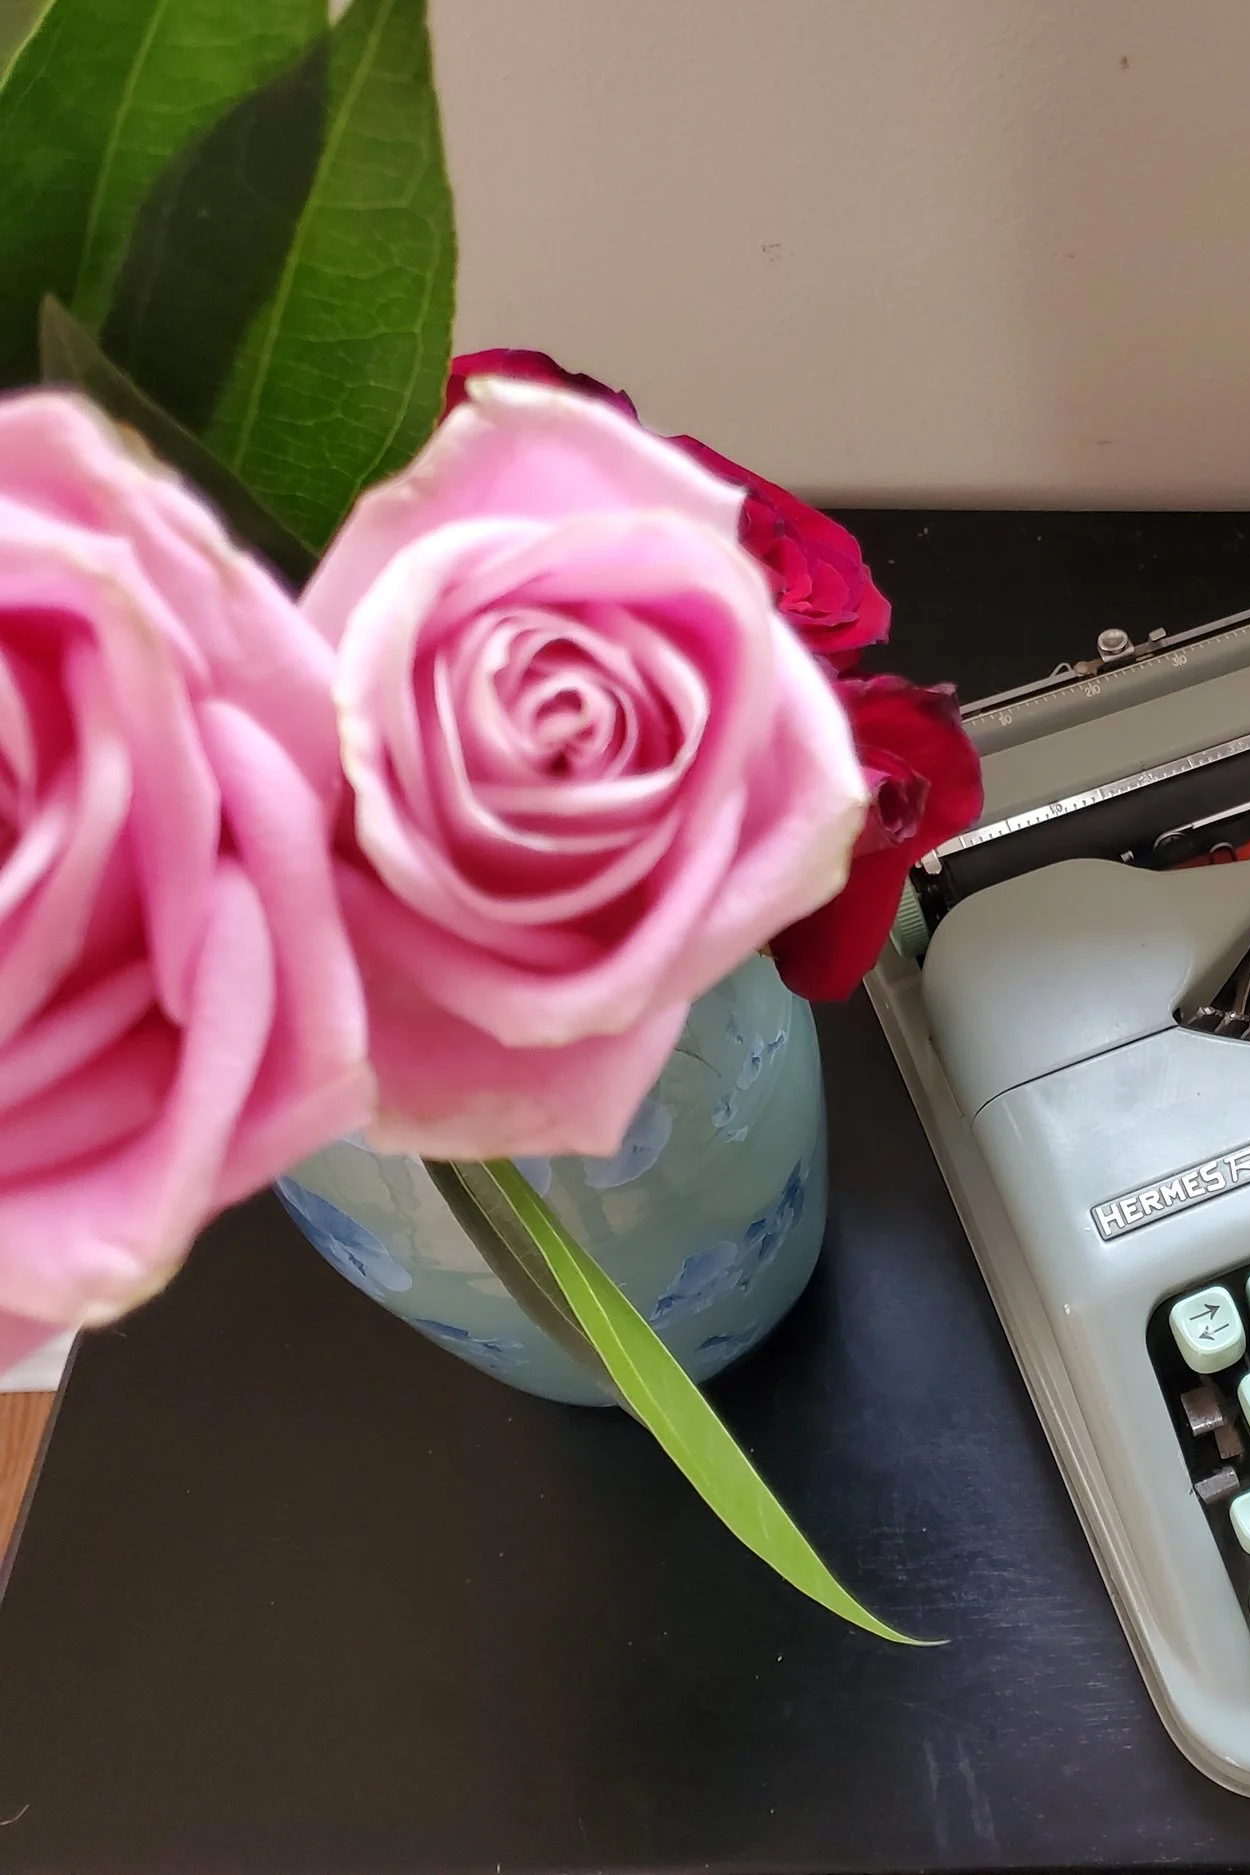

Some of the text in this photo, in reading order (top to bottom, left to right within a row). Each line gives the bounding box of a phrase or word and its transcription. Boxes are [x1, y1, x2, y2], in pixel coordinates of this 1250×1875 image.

[1085, 684, 1101, 697] 20
[1171, 654, 1188, 668] 30
[1096, 1161, 1226, 1236] HERMES
